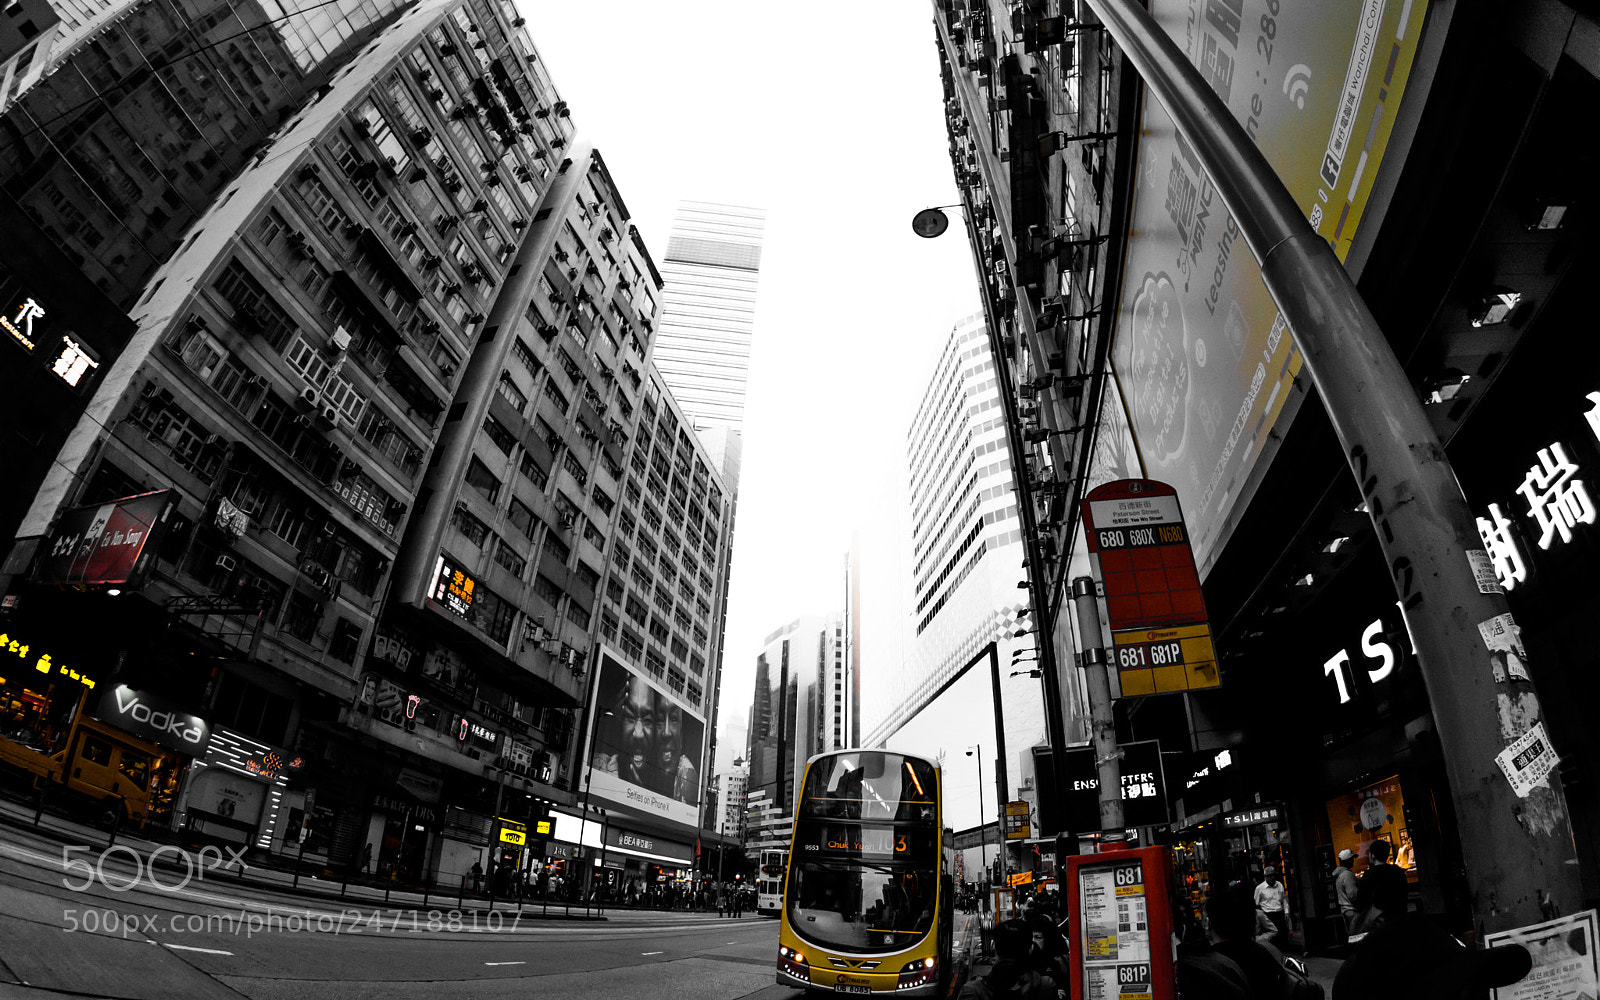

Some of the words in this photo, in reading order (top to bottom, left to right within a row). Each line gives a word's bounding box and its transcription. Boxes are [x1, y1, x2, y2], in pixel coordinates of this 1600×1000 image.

[1350, 32, 1372, 92] Wanchai
[0, 315, 35, 350] Restaurant
[123, 528, 143, 548] Sang
[1099, 530, 1125, 548] 680
[1129, 528, 1156, 546] 680X
[1158, 525, 1184, 543] N680
[1119, 646, 1146, 668] 681
[1150, 643, 1180, 665] 681P
[1323, 601, 1418, 704] TS
[115, 684, 203, 744] Vodka
[626, 787, 643, 803] Selfies
[643, 796, 650, 805] on
[1224, 814, 1249, 824] TSL
[623, 836, 636, 846] BEA
[828, 840, 848, 850] Chuk
[1115, 866, 1142, 886] 681
[1120, 967, 1147, 983] 681P
